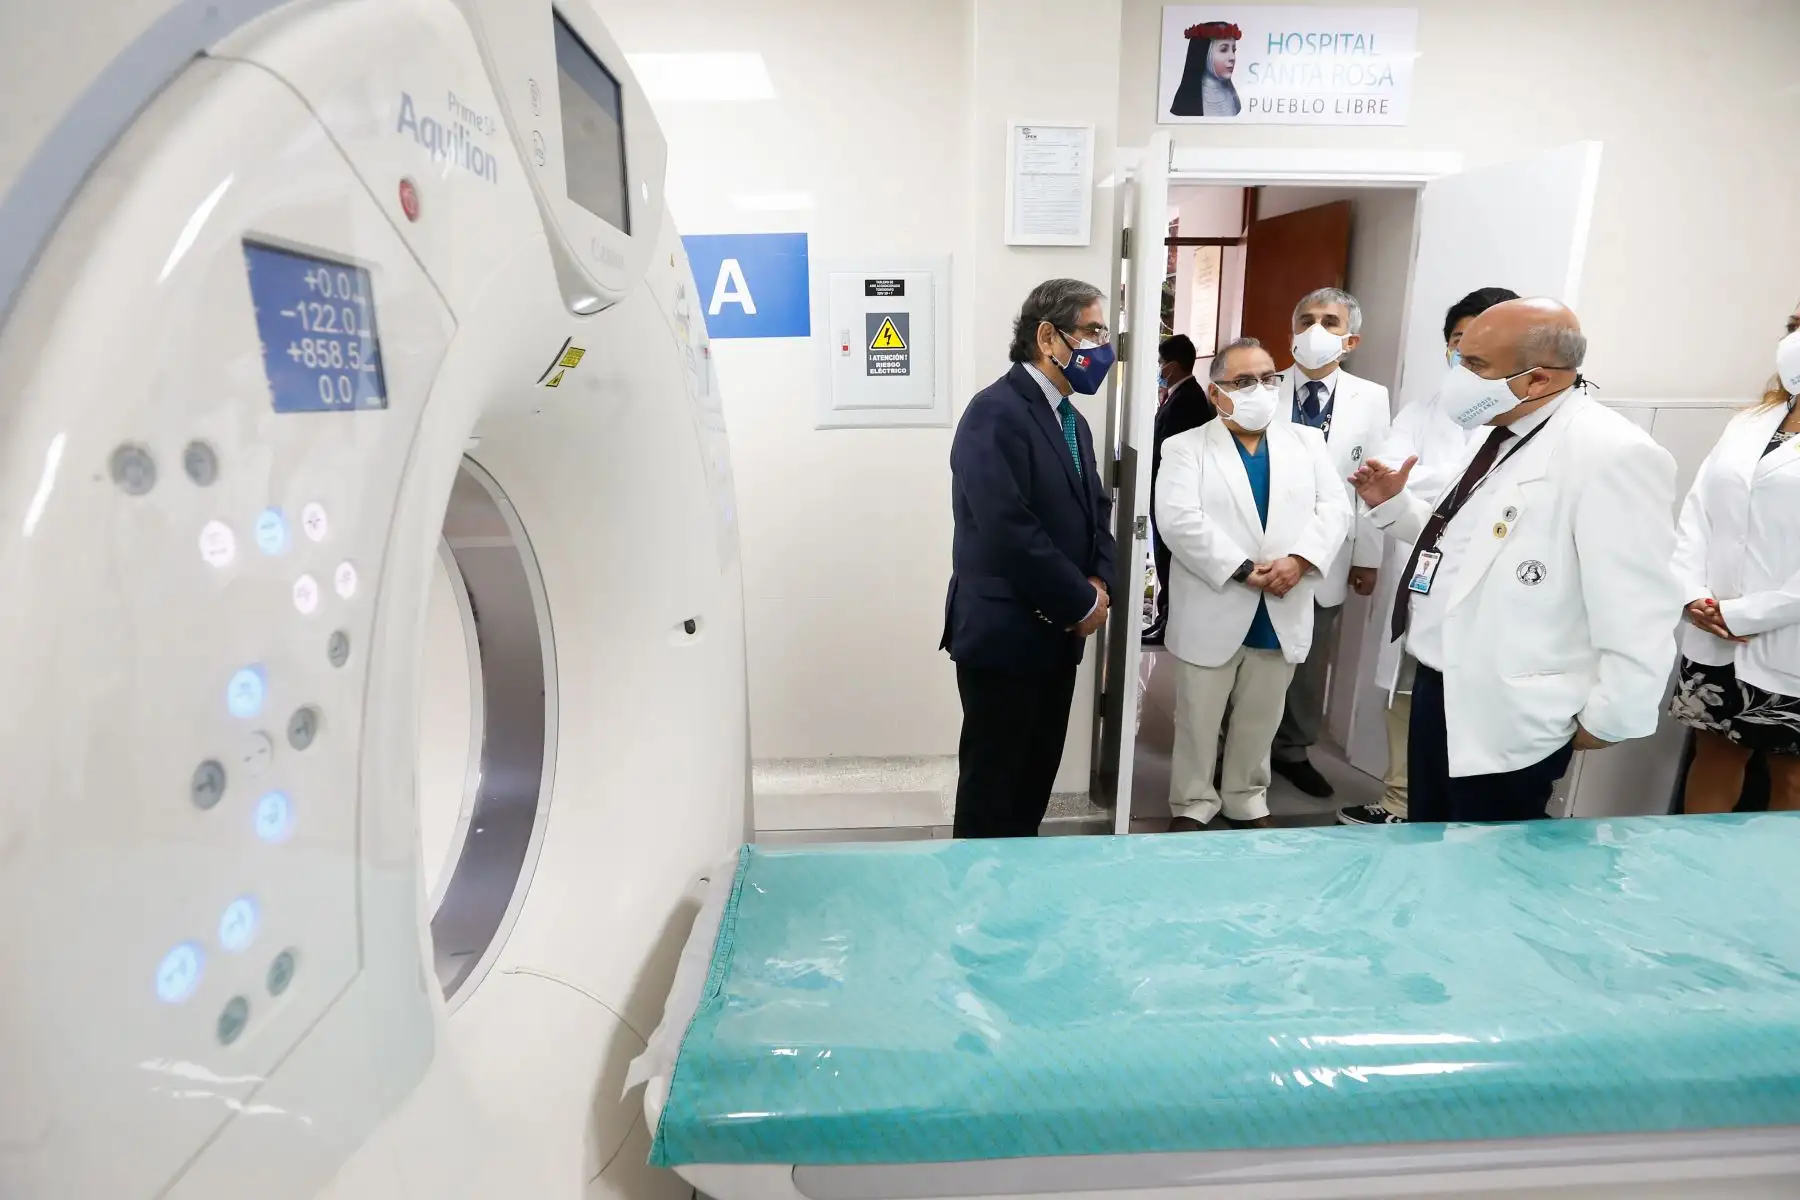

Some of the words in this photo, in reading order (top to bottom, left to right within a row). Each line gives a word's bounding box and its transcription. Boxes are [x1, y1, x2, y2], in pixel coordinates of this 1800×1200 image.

[1267, 32, 1380, 56] HOSPITAL
[1248, 62, 1323, 86] SANTA
[1332, 63, 1394, 87] ROSA
[447, 89, 483, 132] Prime
[1249, 98, 1325, 114] PUEBLO
[1335, 99, 1390, 115] LIBRE
[396, 90, 498, 185] Aquilion
[304, 268, 351, 300] +0.0
[708, 258, 757, 316] A
[280, 300, 355, 338] -122.0
[287, 338, 360, 372] +858.5
[319, 375, 352, 404] 0.0
